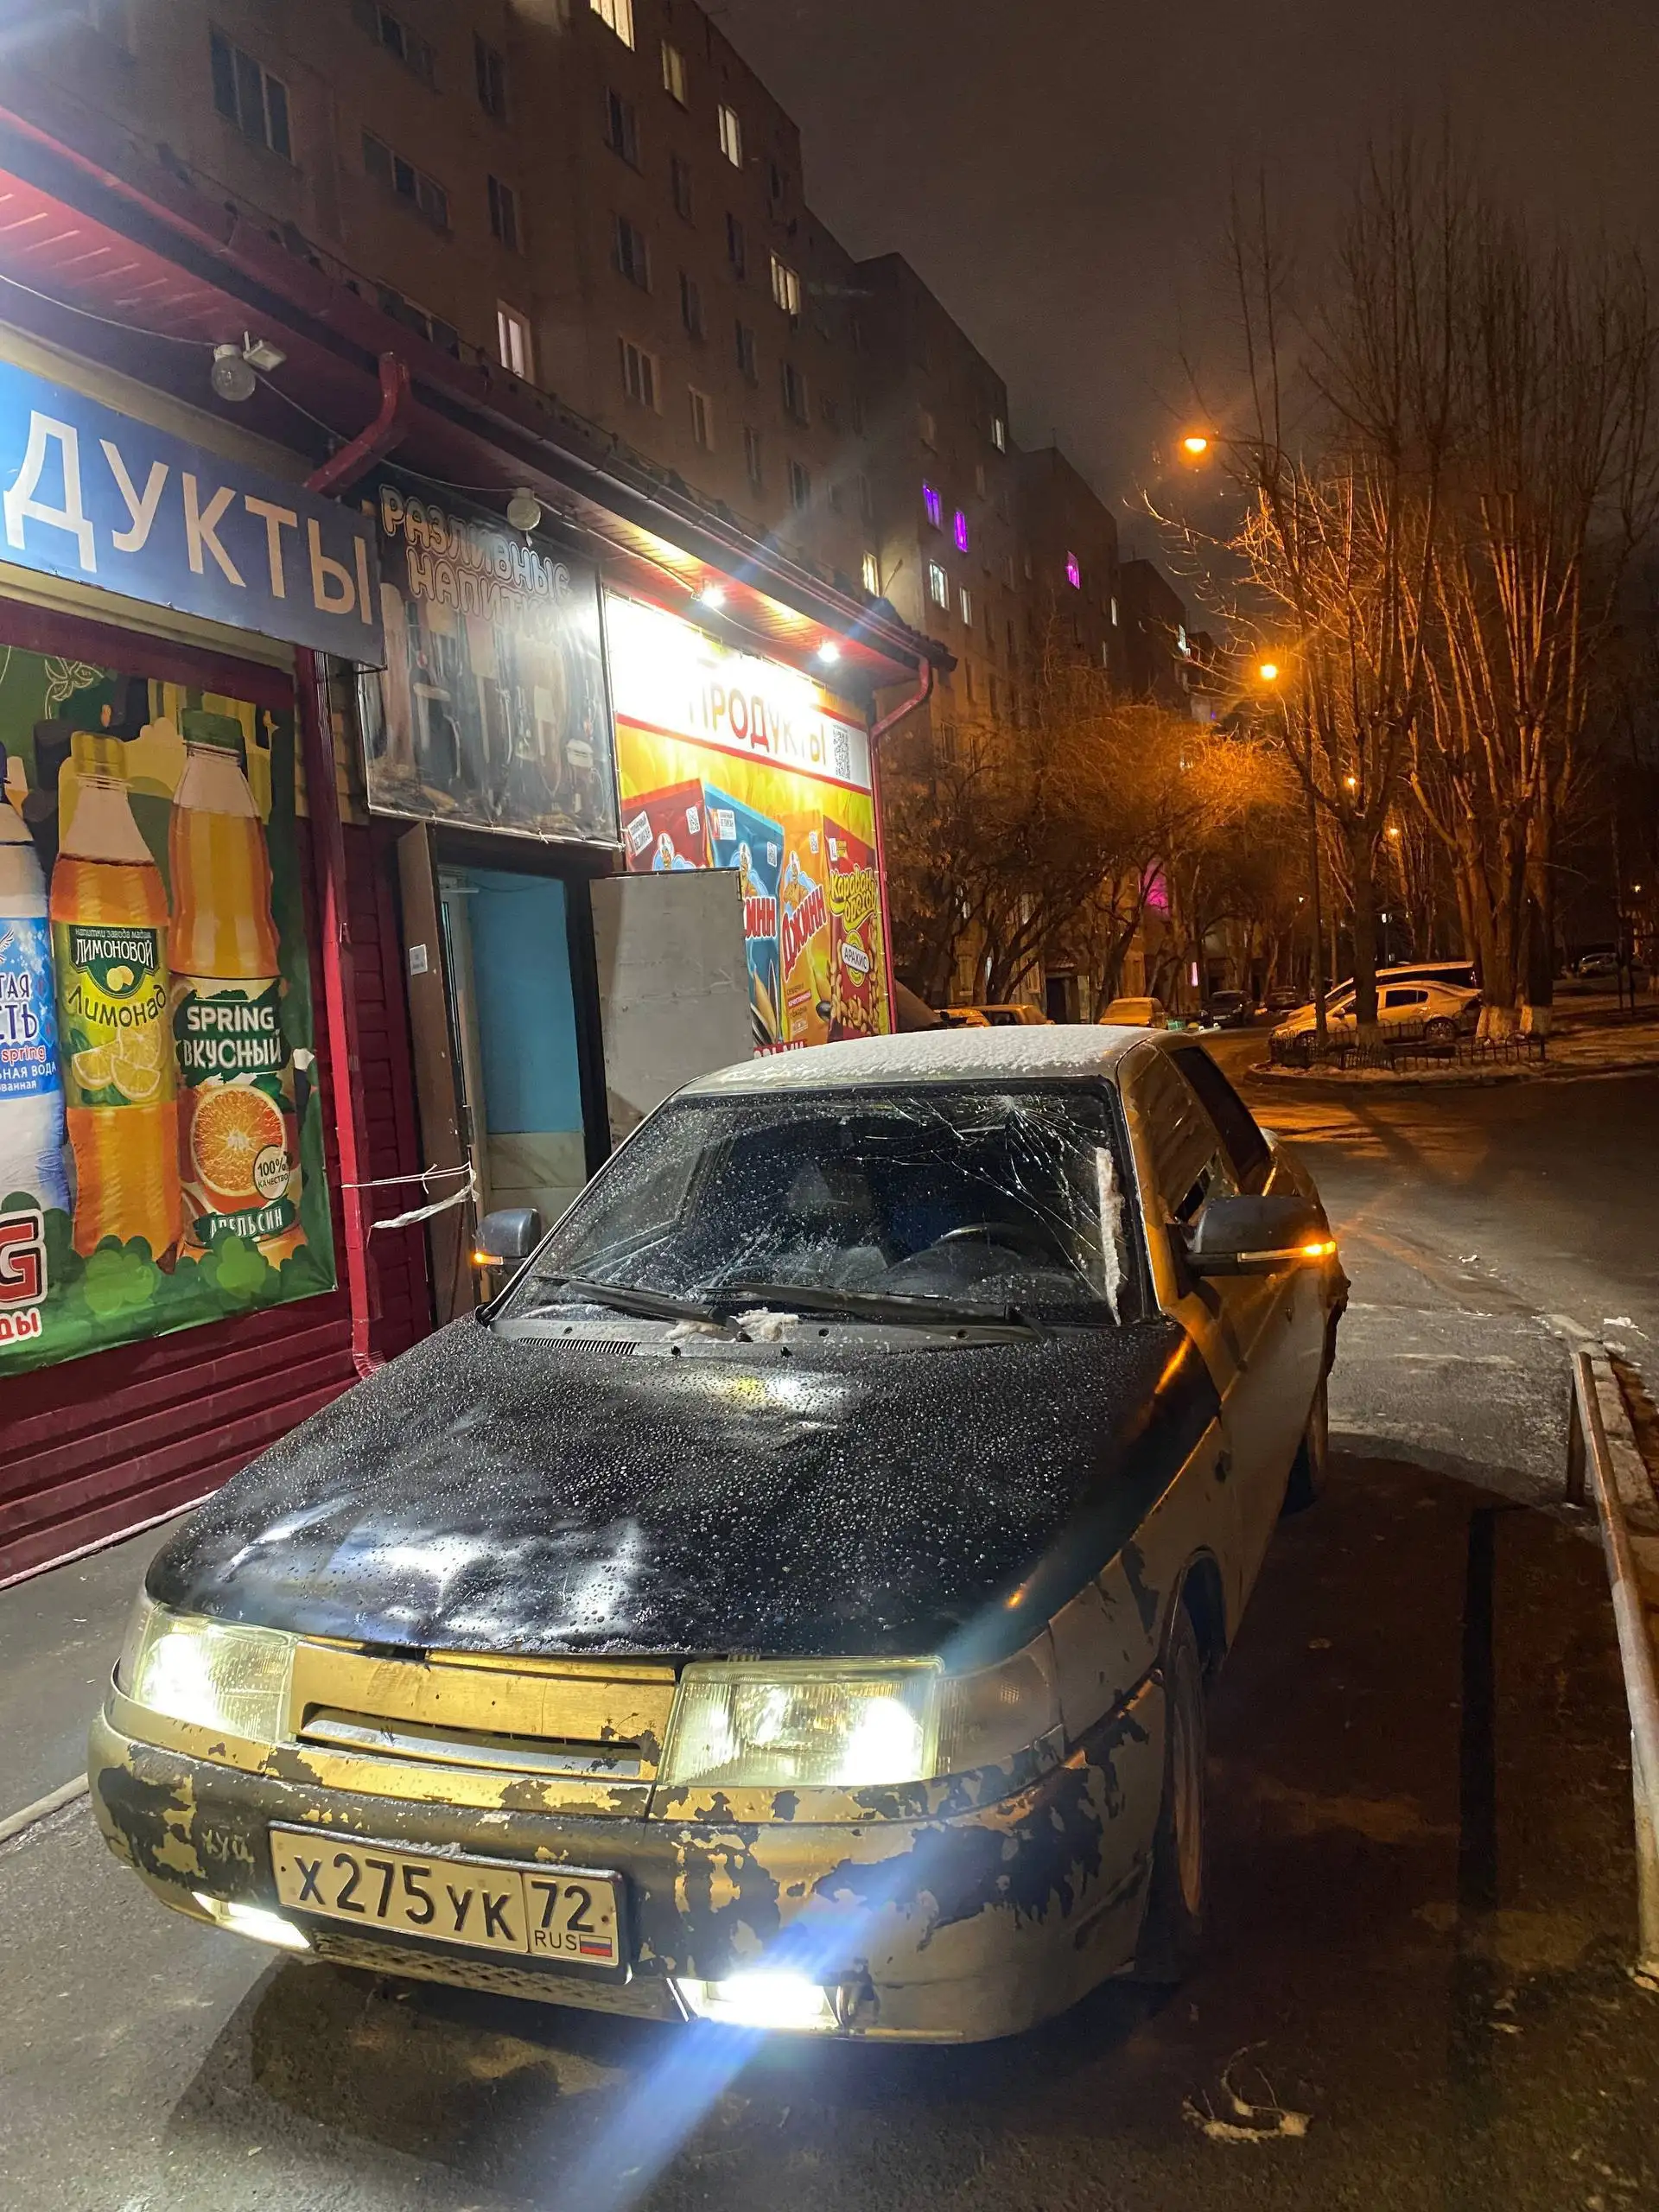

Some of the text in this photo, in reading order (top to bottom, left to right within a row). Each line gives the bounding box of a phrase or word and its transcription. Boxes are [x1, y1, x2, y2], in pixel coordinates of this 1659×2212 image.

[3, 410, 372, 625] ДУКТЫ
[406, 546, 562, 645] НАПИТ
[76, 938, 154, 969] ЛИМОНОВОЙ
[843, 947, 867, 969] АРАХИС
[0, 1004, 39, 1039] ТЬ
[68, 984, 167, 1028] Лимонад
[187, 1004, 275, 1032] SPRING
[2, 1046, 46, 1065] spring
[182, 1028, 283, 1069] ВКУСНЫЙ
[31, 1062, 57, 1077] ВОДА
[257, 1157, 286, 1177] 100%
[257, 1172, 289, 1189] КАЧЕСТВО
[209, 1207, 283, 1239] АПЕЛЬСИН
[531, 1880, 595, 1934] 72
[534, 1929, 577, 1952] RUS
